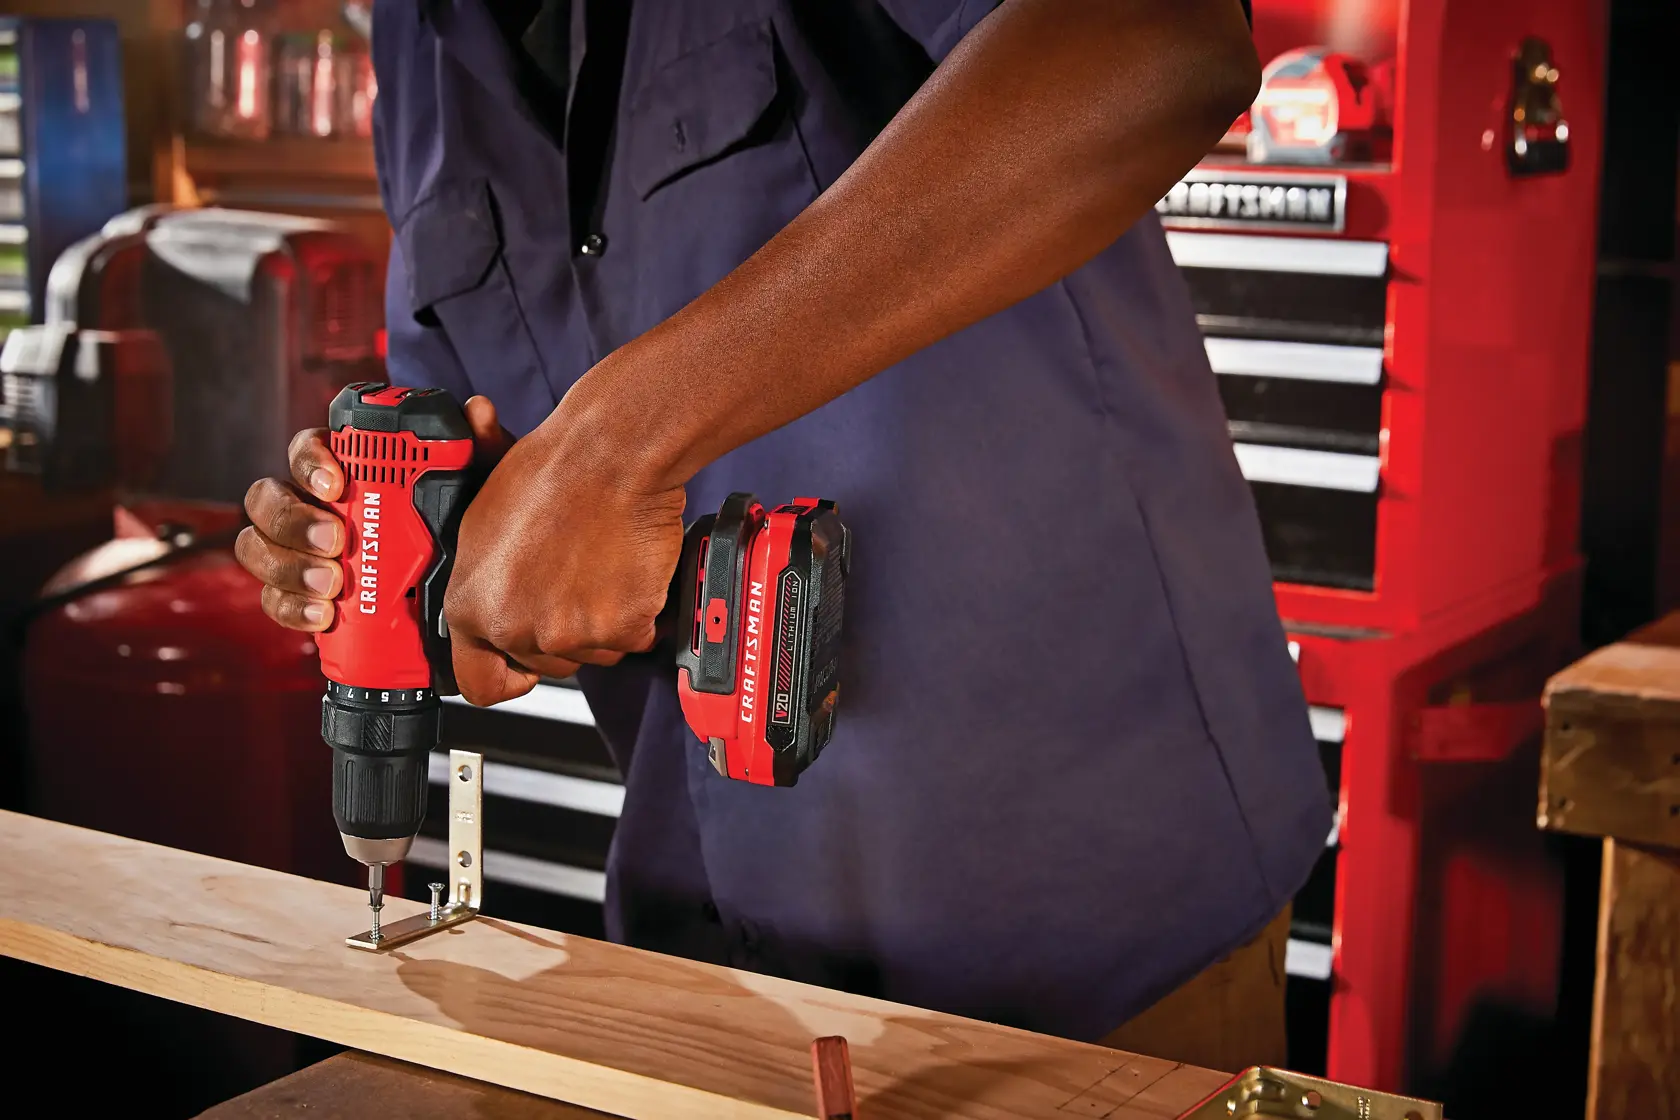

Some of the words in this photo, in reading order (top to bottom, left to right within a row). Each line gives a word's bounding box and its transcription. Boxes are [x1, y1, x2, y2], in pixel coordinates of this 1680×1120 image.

[359, 492, 381, 614] CRAFTSMAN
[791, 580, 799, 598] ION
[787, 606, 797, 651] LITHIUM
[741, 581, 763, 723] CRAFTSMAN
[347, 688, 354, 699] 7
[381, 691, 390, 702] 5
[416, 690, 423, 701] 3
[775, 693, 789, 718] V20
